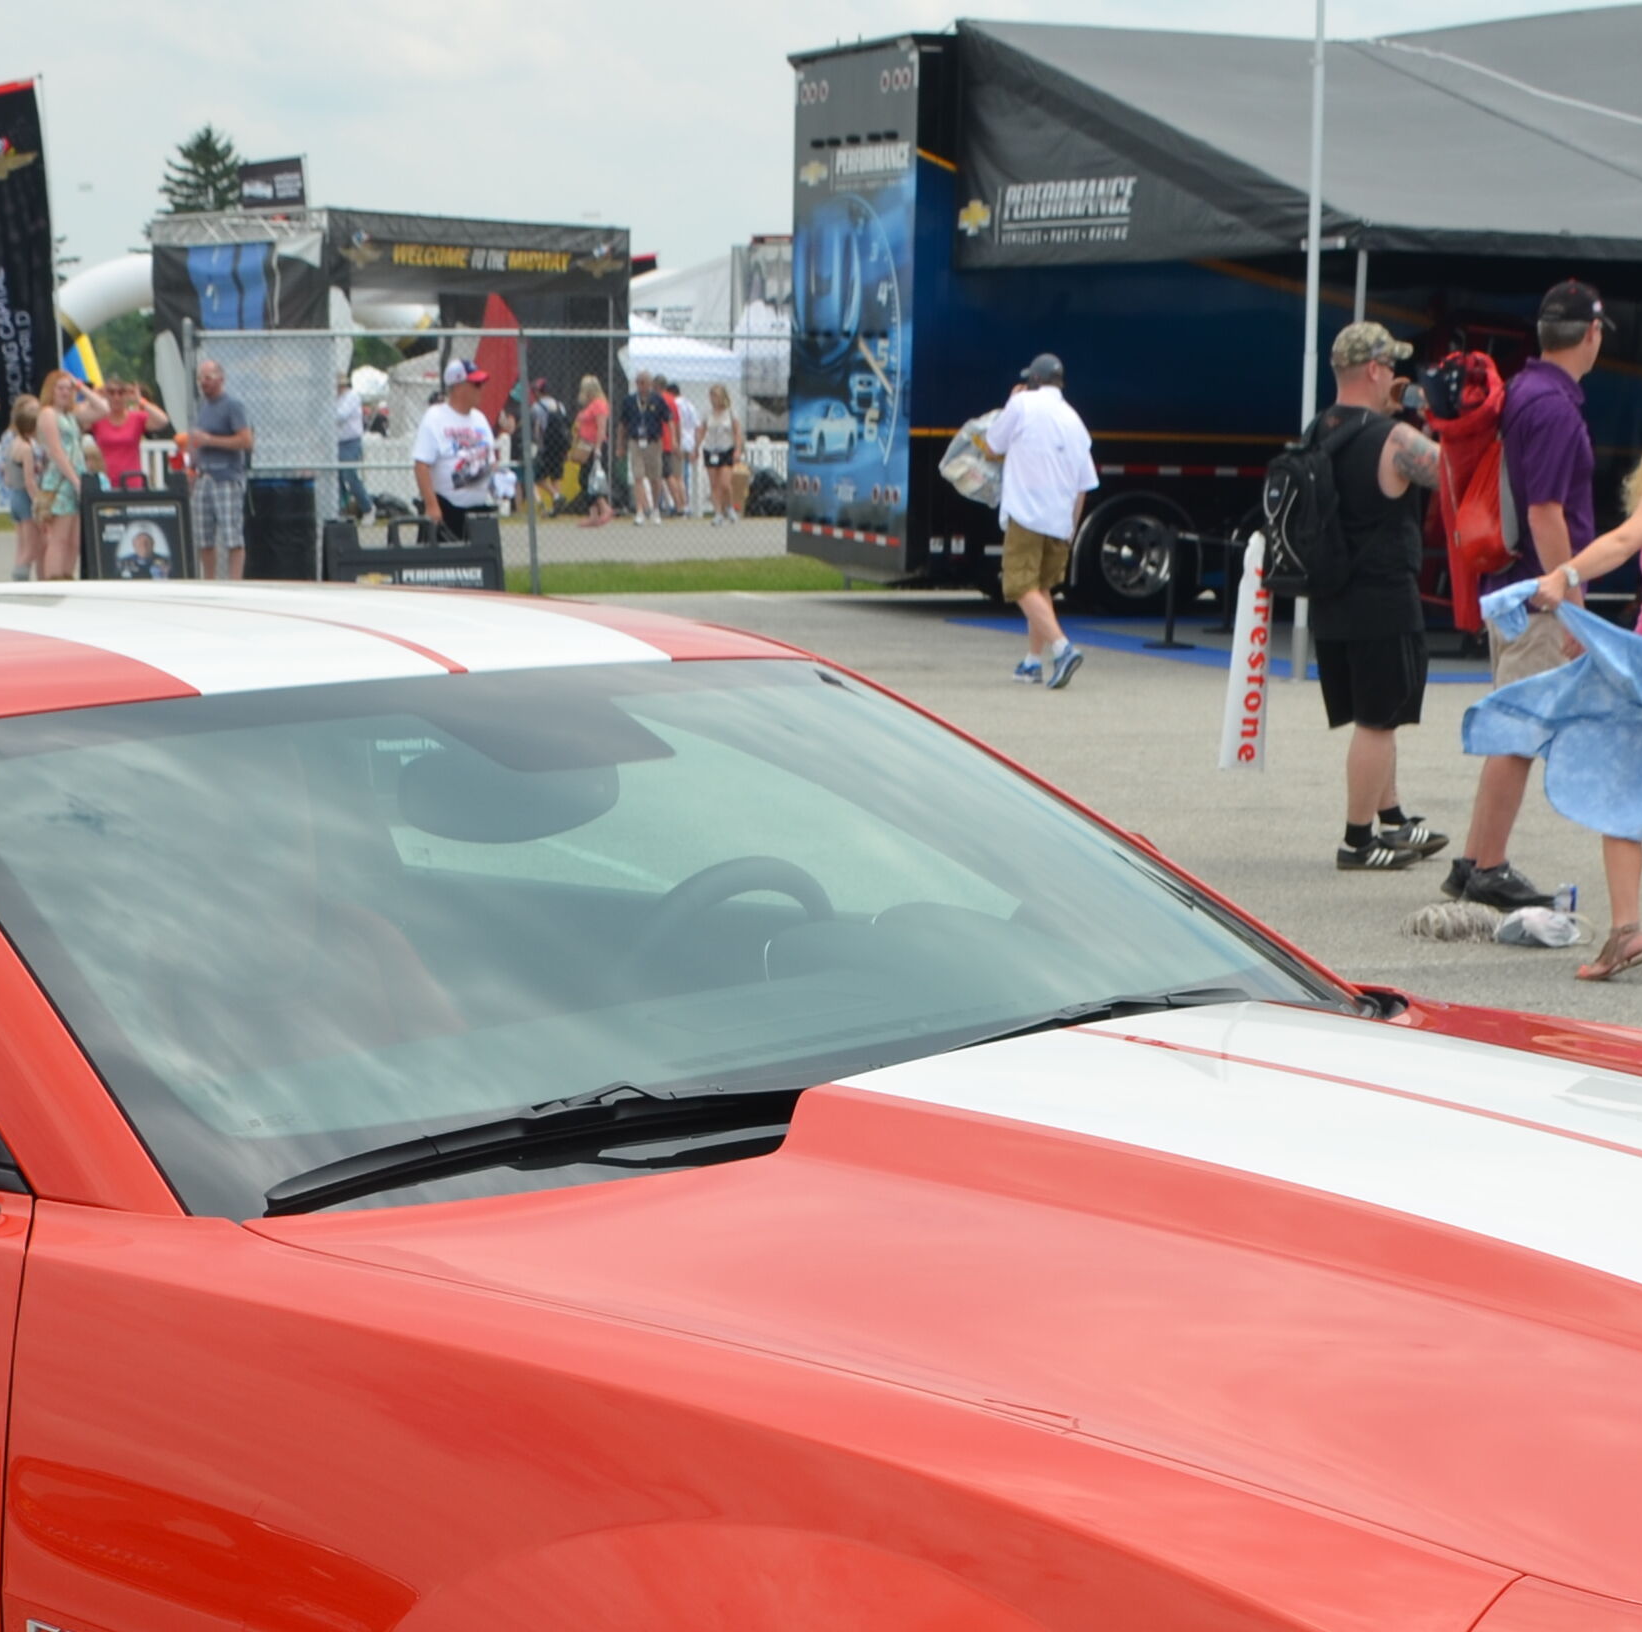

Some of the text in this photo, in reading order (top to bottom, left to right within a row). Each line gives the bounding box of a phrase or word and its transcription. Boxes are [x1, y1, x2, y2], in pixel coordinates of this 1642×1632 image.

[1003, 176, 1138, 221] PERFORMANCE
[393, 243, 470, 269] WELCOME
[508, 250, 572, 273] MIDWAY
[402, 568, 483, 584] PERFORMANCE
[1237, 568, 1270, 764] irestone
